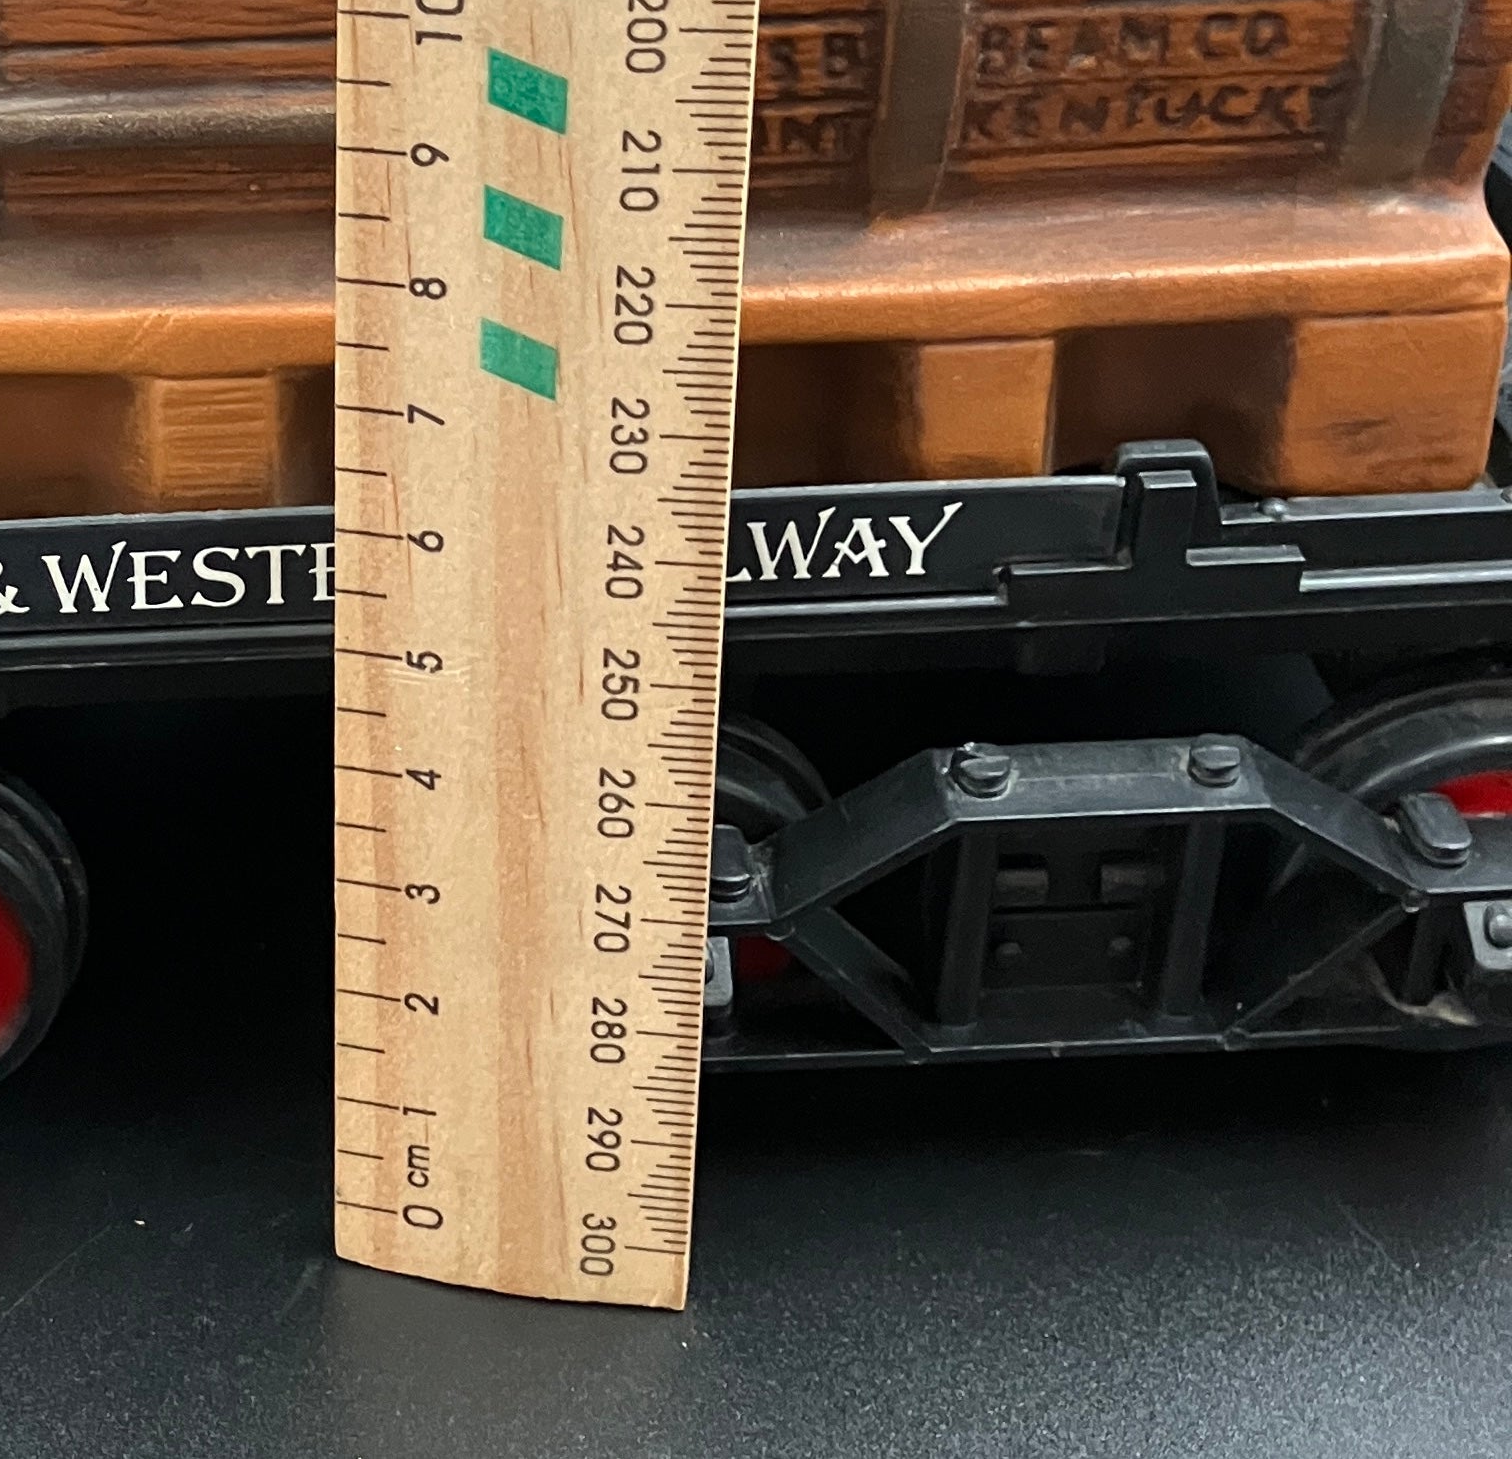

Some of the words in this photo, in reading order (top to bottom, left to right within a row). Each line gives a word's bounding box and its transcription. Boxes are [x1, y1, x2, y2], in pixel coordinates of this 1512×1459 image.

[410, 143, 451, 168] 9
[620, 129, 664, 214] 210
[409, 275, 449, 302] 8
[614, 264, 658, 347] 220
[407, 404, 447, 427] 7
[609, 397, 652, 476] 230
[407, 531, 446, 554] 6
[605, 524, 647, 601] 240
[406, 651, 445, 674] 5
[601, 648, 642, 722] 250
[405, 769, 443, 791] 4
[597, 767, 638, 840] 260
[404, 883, 442, 906] 3
[594, 883, 634, 954] 270
[404, 993, 441, 1016] 2
[590, 996, 630, 1065] 280
[408, 1146, 430, 1188] cm
[585, 1106, 624, 1174] 290
[403, 1205, 445, 1231] 0
[580, 1212, 618, 1278] 300
